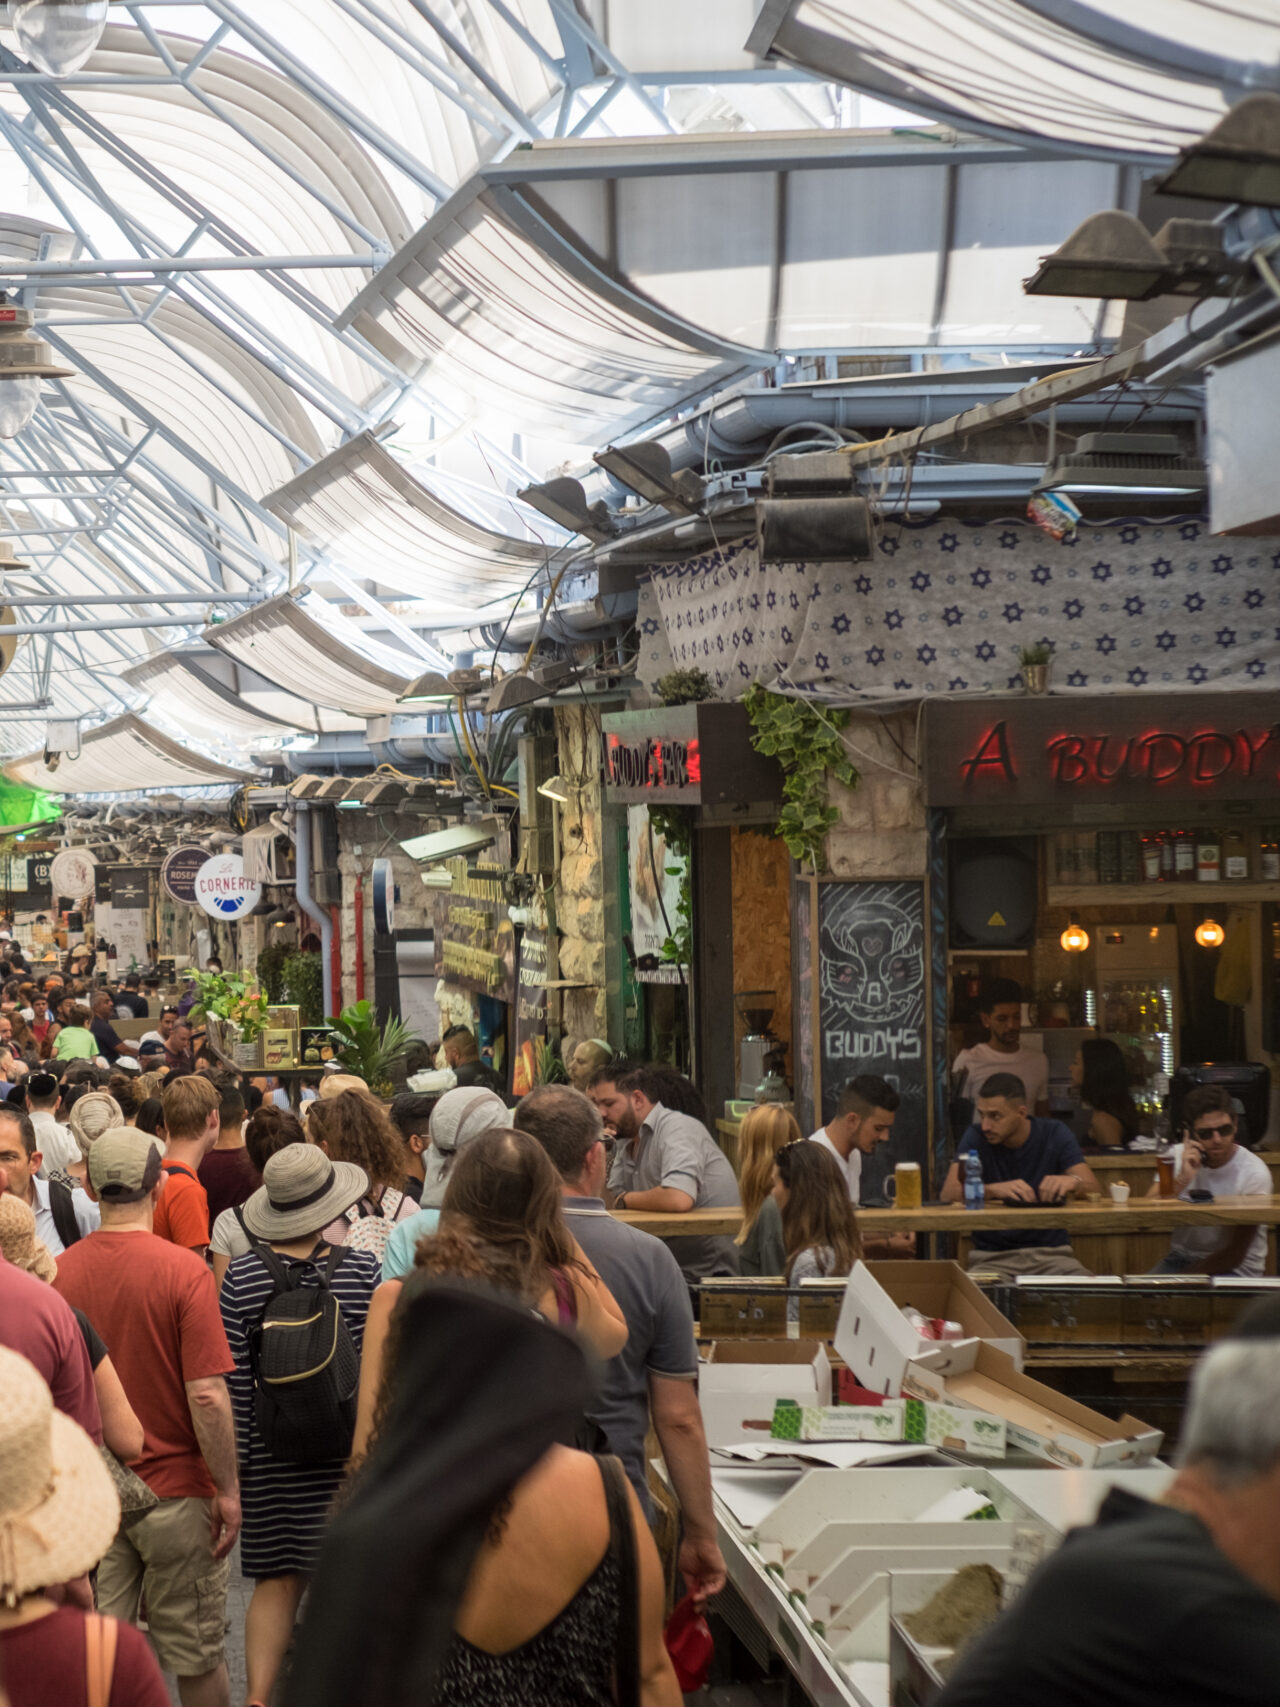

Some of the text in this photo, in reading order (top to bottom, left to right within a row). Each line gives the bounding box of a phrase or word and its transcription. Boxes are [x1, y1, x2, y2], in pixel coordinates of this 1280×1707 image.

[600, 732, 689, 788] A BUDDY'S BAR
[959, 719, 1018, 787] A
[200, 876, 256, 894] CORNERIE
[867, 982, 882, 1003] A
[826, 1028, 921, 1060] BUDDYS
